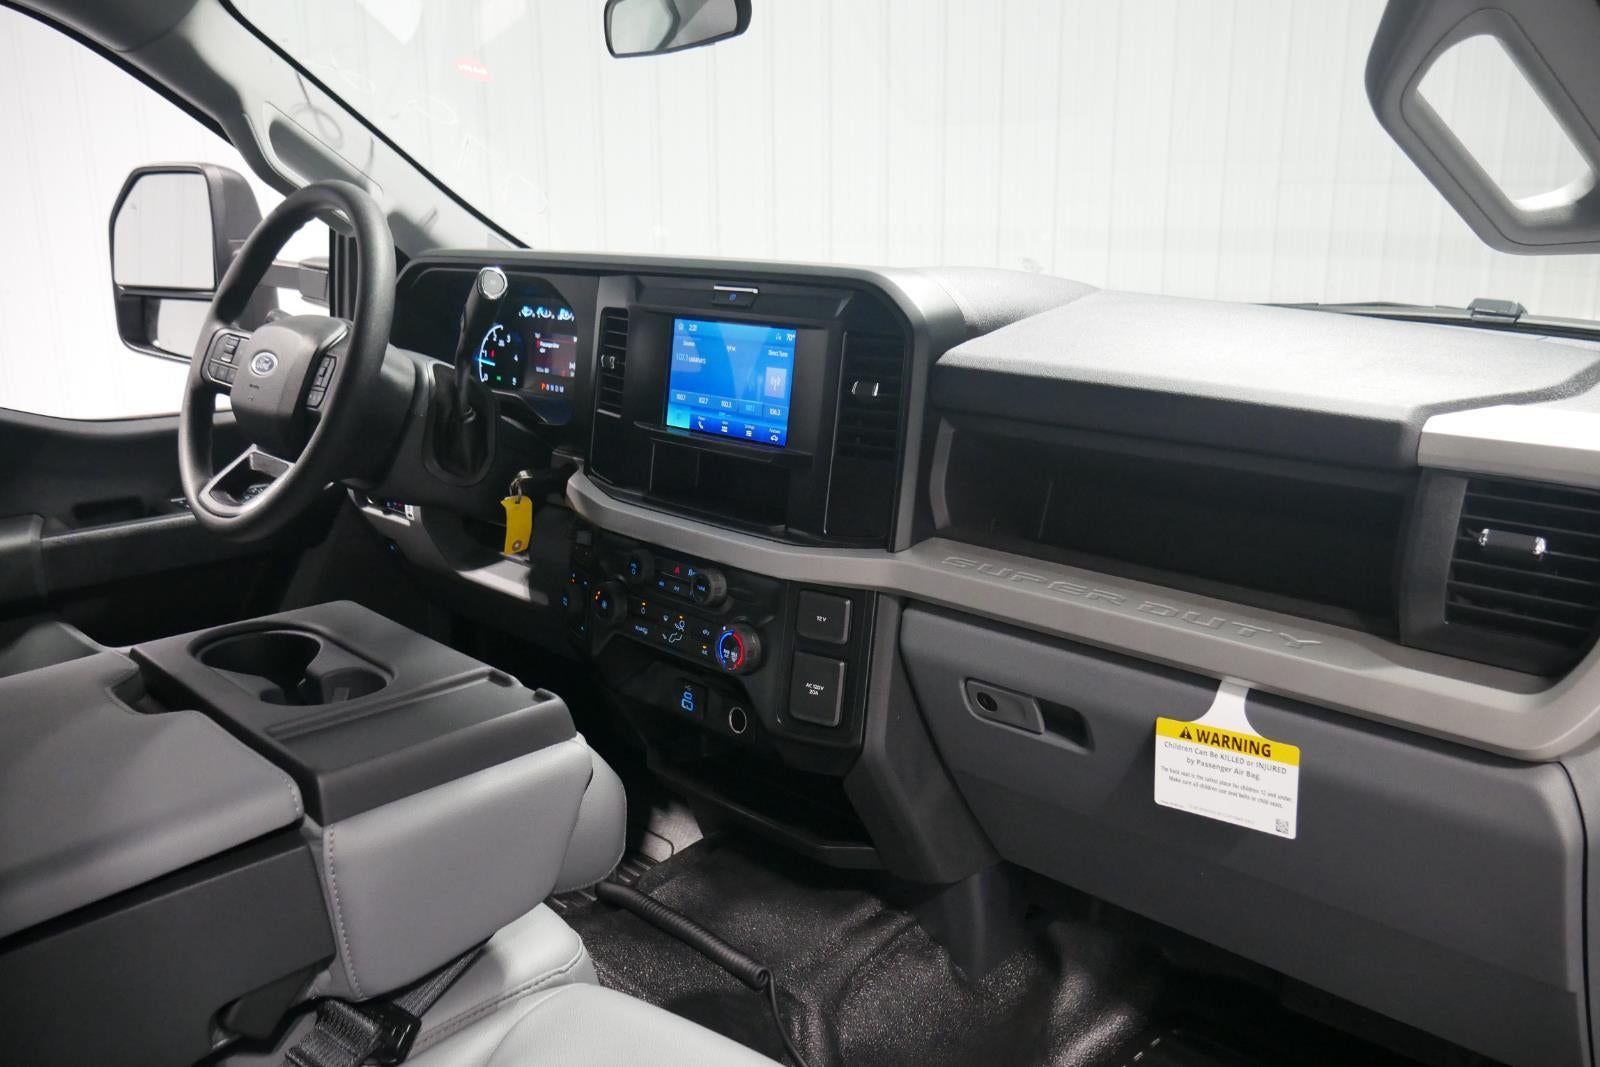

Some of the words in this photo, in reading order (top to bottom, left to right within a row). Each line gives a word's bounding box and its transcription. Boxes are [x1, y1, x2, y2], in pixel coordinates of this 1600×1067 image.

[941, 555, 1127, 608] SUPER
[1136, 600, 1324, 649] DUTY
[1164, 740, 1193, 753] Children
[1194, 748, 1208, 757] Can
[1210, 751, 1219, 759] Be
[1220, 754, 1245, 766] KILLED
[1246, 759, 1254, 767] or
[1256, 761, 1287, 775] INJURED
[1196, 728, 1272, 757] WARNING
[1186, 757, 1195, 766] by
[1197, 758, 1234, 773] Passenger
[1234, 767, 1244, 777] Air
